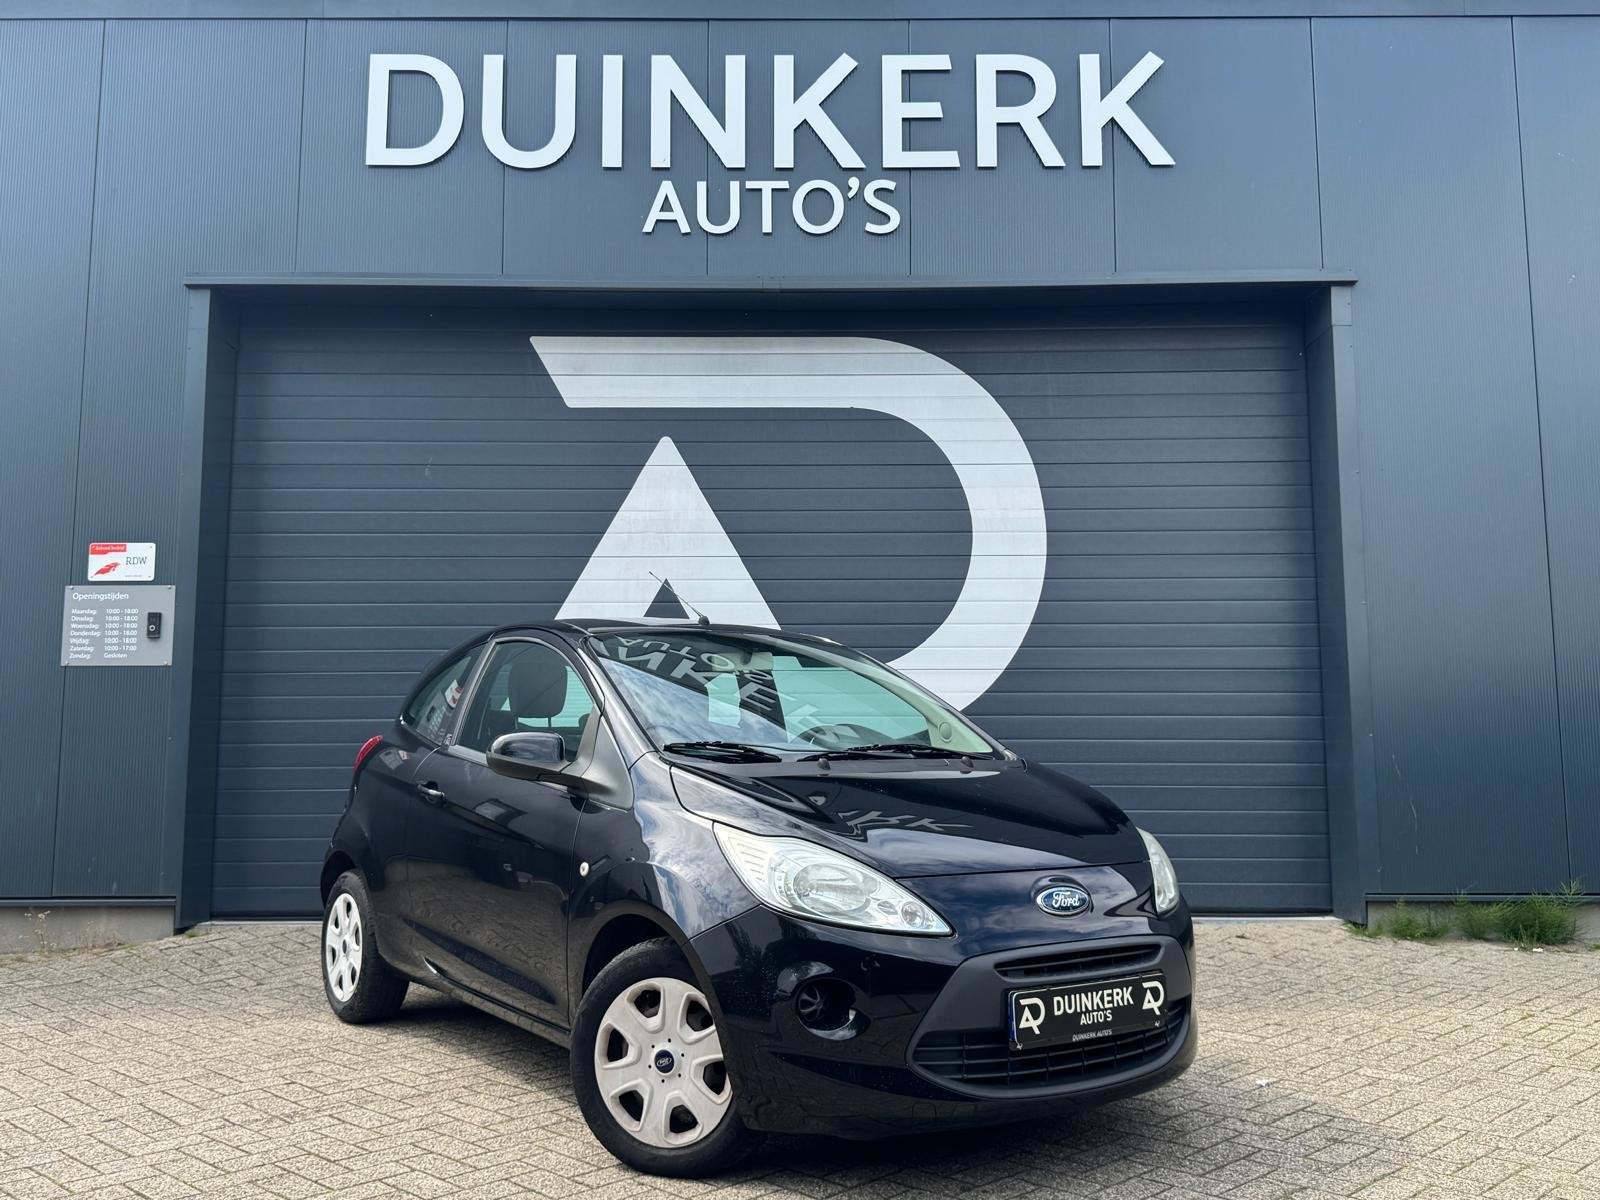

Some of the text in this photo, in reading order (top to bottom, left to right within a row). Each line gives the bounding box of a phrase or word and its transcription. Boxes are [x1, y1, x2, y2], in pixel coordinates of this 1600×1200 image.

[365, 50, 1177, 169] DUINKERK
[641, 176, 901, 235] AUTO'S
[126, 556, 147, 566] RDW
[73, 592, 129, 602] Openingstijden
[1052, 891, 1079, 908] Ford
[1053, 986, 1134, 1016] DUINKERK
[1080, 1009, 1112, 1025] AUTO'S
[1072, 1031, 1097, 1042] DUINKERK
